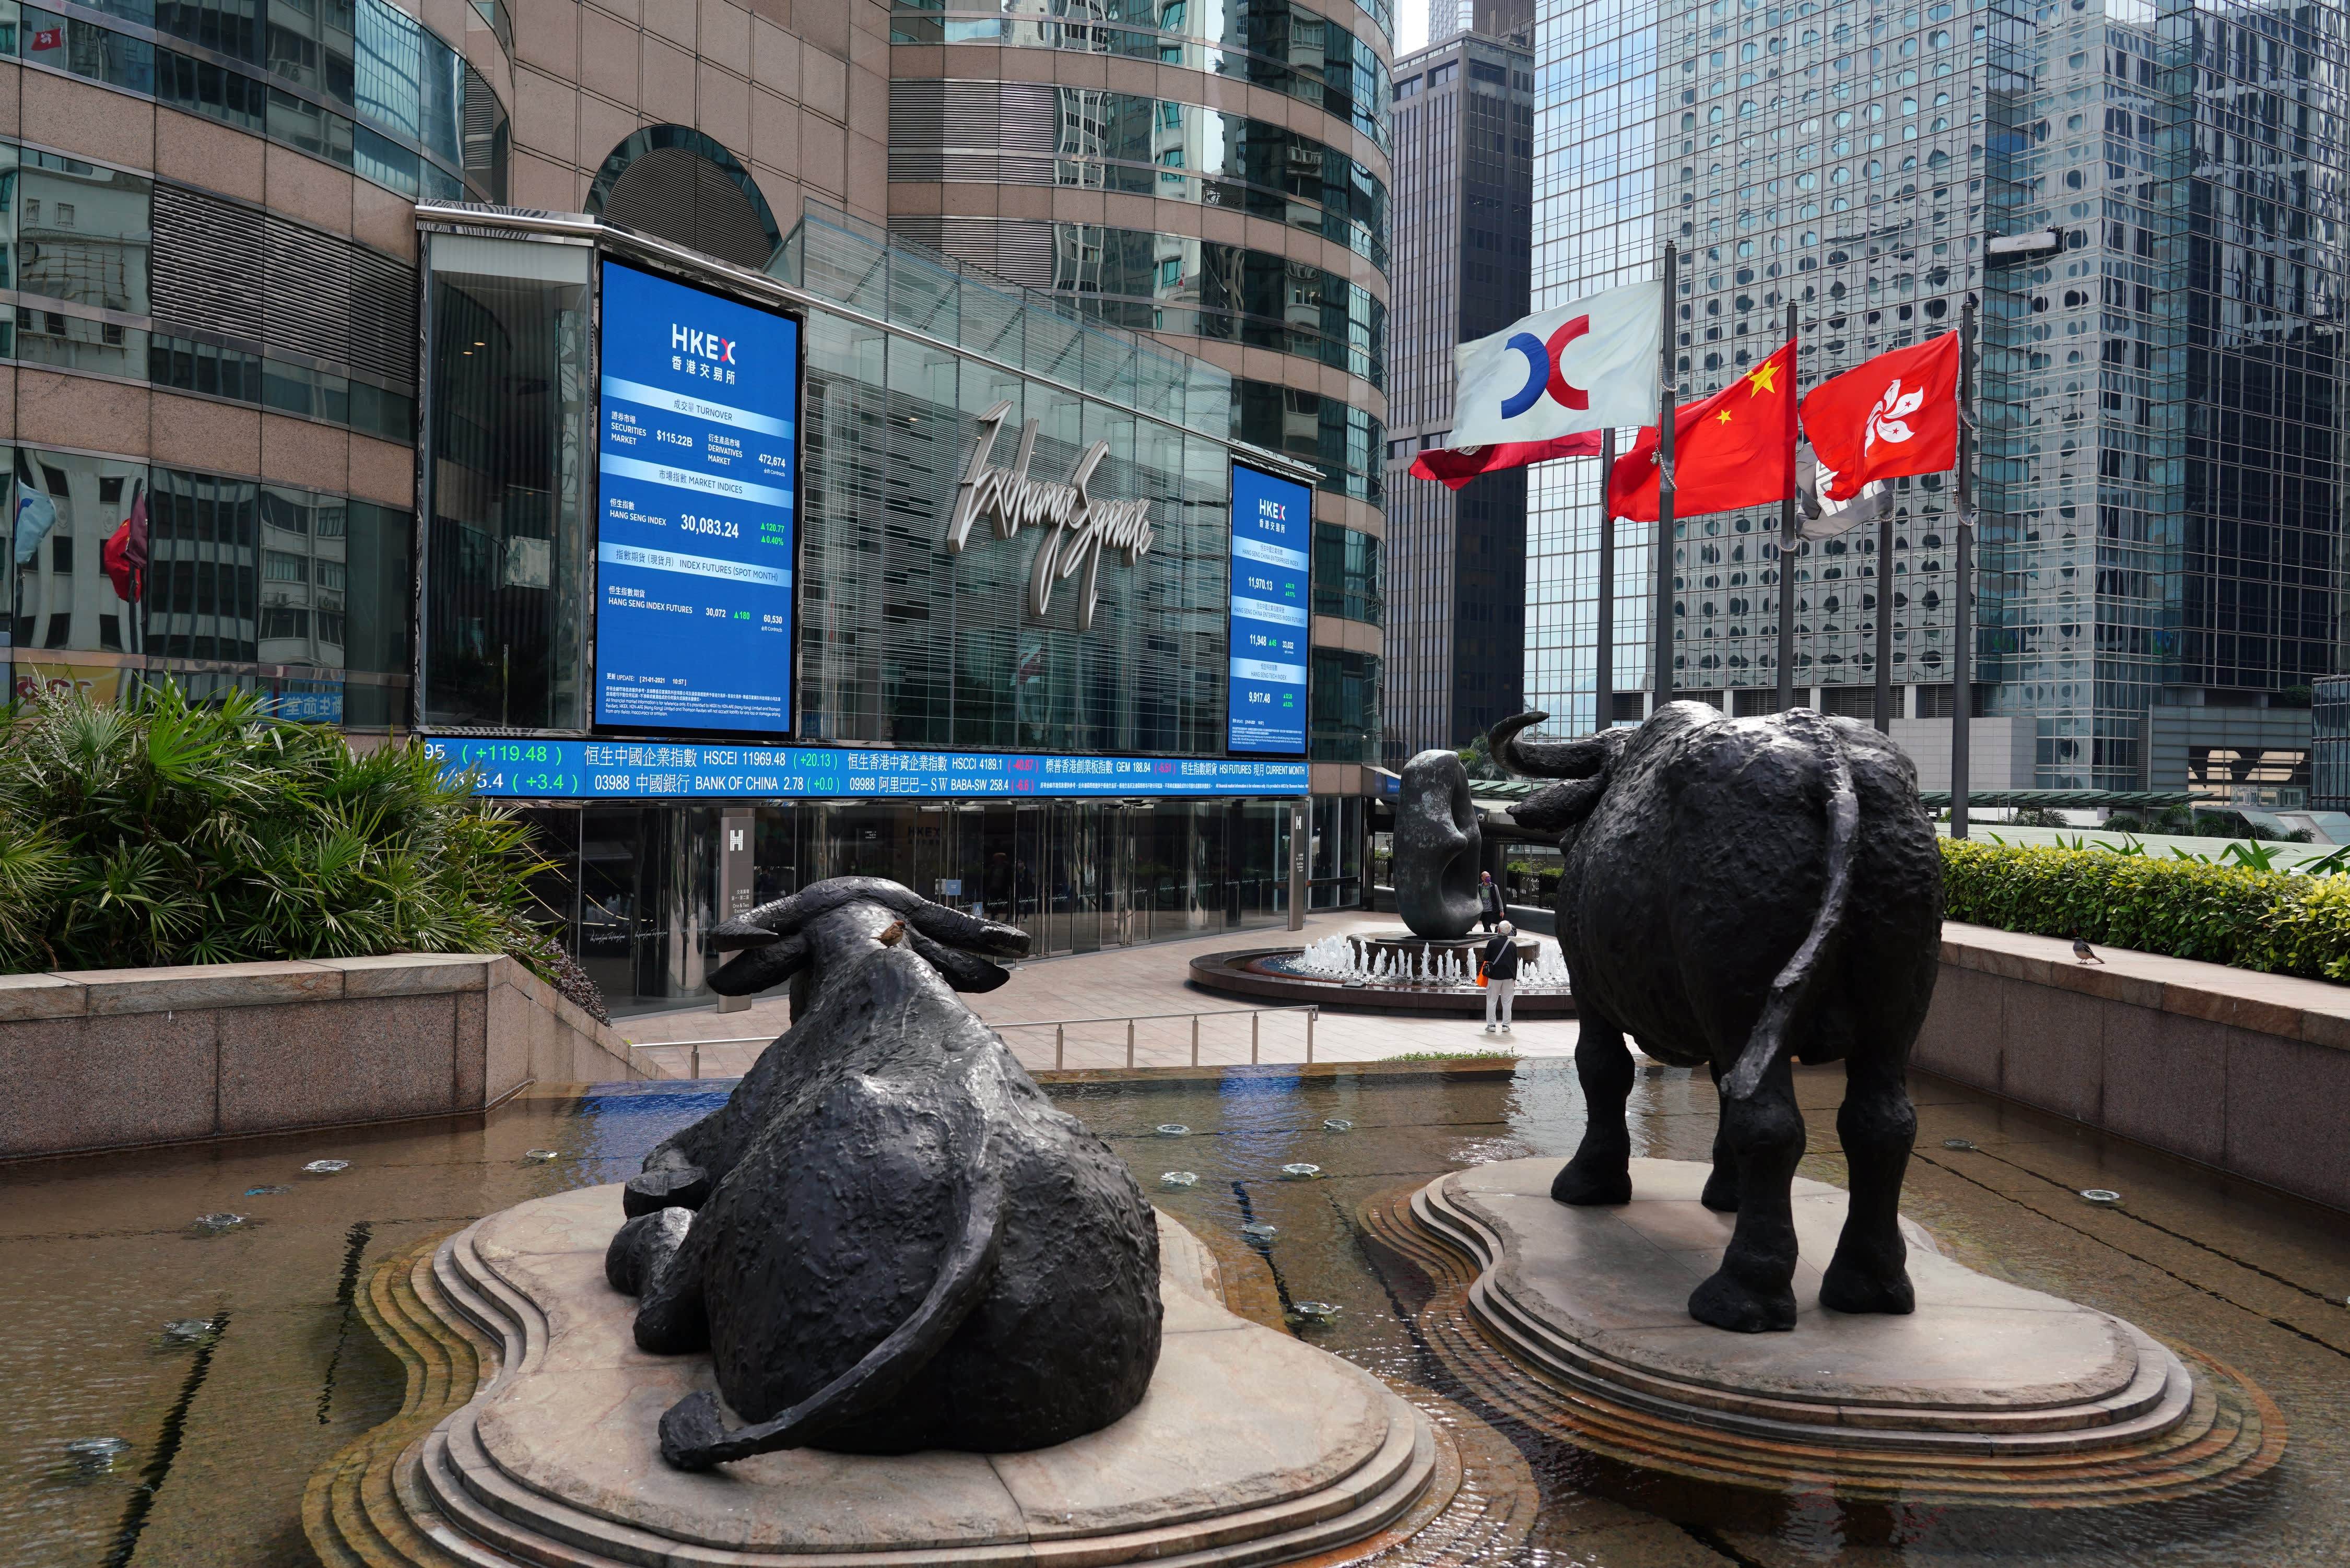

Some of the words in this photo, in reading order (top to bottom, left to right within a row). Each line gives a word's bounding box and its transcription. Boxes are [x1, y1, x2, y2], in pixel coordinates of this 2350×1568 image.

[672, 323, 736, 365] HKEX
[672, 356, 735, 385] 香港交易所
[612, 411, 636, 424] 證券市場
[674, 399, 694, 412] 成交量
[696, 405, 733, 421] TURNOVER
[611, 422, 647, 437] SECURITIES
[611, 433, 637, 445] MARKET
[656, 430, 693, 447] $115.22B
[708, 433, 740, 448] 衍生產品市場
[708, 444, 743, 458] DERIVATIVES
[708, 454, 731, 466] MARKET
[758, 453, 786, 468] 472,674
[659, 469, 687, 484] 市場指數
[689, 476, 715, 489] MARKET
[718, 482, 743, 494] INDICES
[610, 498, 634, 511] 恒生指數
[1259, 498, 1286, 521] HKEX
[610, 509, 628, 520] HANG
[630, 513, 647, 523] SENG
[648, 516, 666, 526] INDEX
[680, 513, 738, 538] 30,083.24
[766, 522, 785, 533] 120.77
[1259, 518, 1285, 534] 香港交易所
[766, 535, 784, 546] 0.40%
[1271, 555, 1289, 564] ENTERPRISES
[680, 560, 701, 570] INDEX
[702, 563, 732, 574] FUTURES
[733, 566, 751, 577] (SPOT
[753, 570, 778, 582] MONTH)
[1248, 576, 1273, 591] 11,970.13
[608, 585, 645, 598] 恒生指數期貨
[608, 597, 627, 606] HANG
[628, 599, 645, 609] SENG
[646, 602, 665, 611] INDEX
[666, 604, 693, 614] FUTURES
[706, 607, 726, 618] 30,072
[739, 611, 750, 620] 180
[763, 614, 783, 625] 60,530
[1263, 611, 1282, 620] ENTERPRISES
[1291, 616, 1305, 624] FUTURES
[1250, 634, 1266, 647] 11,948
[1282, 641, 1294, 650] 33,032
[1249, 691, 1271, 704] 9,917.48
[585, 745, 697, 768] 恒生中國企業指數
[703, 750, 737, 765] HSCEI
[743, 751, 785, 767] 11969.48
[848, 752, 947, 772] 恒生香港中資企業指數
[952, 757, 977, 770] HSCCI
[979, 758, 1002, 771] 4189.1
[1045, 758, 1113, 774] 標普香港創業板指數
[1116, 761, 1131, 772] GEM
[1133, 762, 1151, 773] 188.84
[1181, 762, 1217, 776] 恒生指數期貨
[1219, 765, 1228, 774] HSI
[1229, 765, 1252, 774] FUTURES
[1253, 764, 1264, 776] 現月
[1266, 765, 1288, 774] CURRENT
[1288, 765, 1305, 775] MONTH
[595, 775, 630, 791] 03988
[636, 773, 690, 793] 中國銀行
[696, 776, 726, 791] BANK
[728, 776, 743, 791] OF
[745, 776, 779, 791] CHINA
[783, 777, 804, 791] 2.78
[850, 778, 875, 792] 09988
[951, 779, 987, 792] BABA-SW
[990, 779, 1009, 791] 258.4
